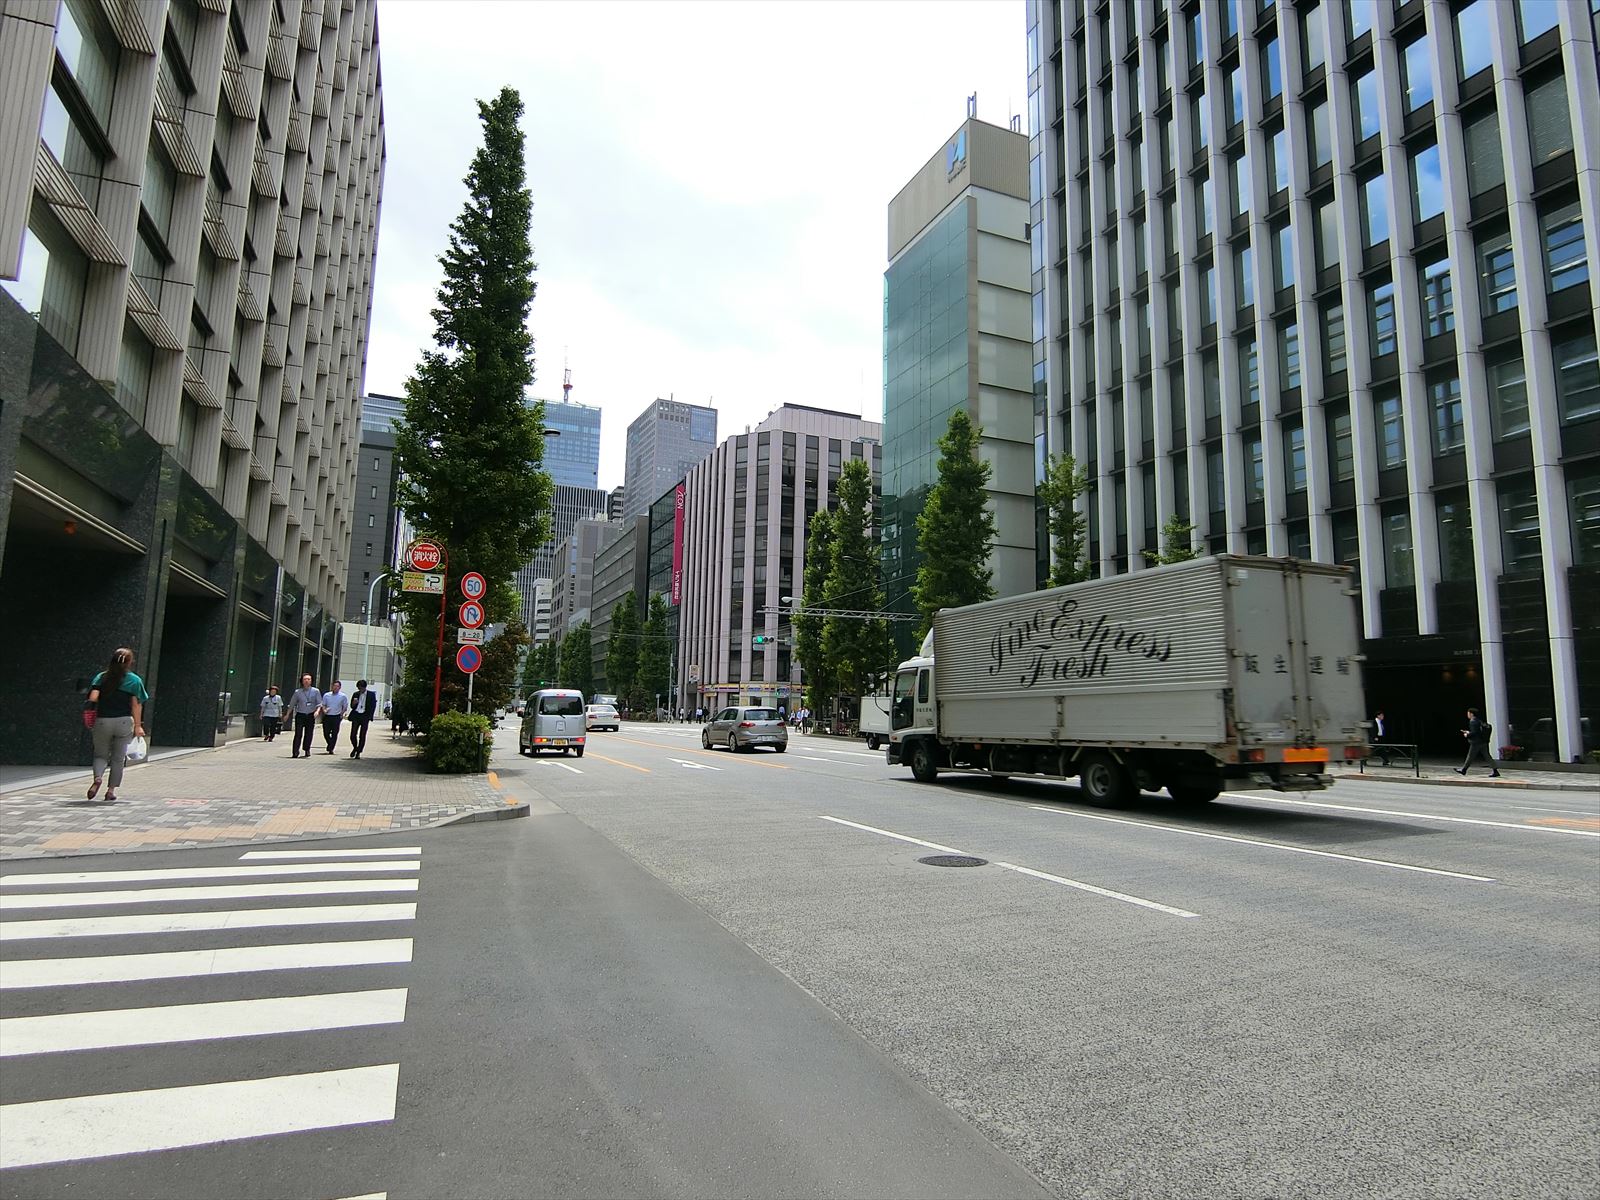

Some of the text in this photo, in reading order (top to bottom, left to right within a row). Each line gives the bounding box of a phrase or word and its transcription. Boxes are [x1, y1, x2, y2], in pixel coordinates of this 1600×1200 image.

[413, 550, 438, 563] 消火栓
[467, 580, 480, 592] 50
[1051, 596, 1172, 662] Express
[1020, 644, 1108, 688] Fresh
